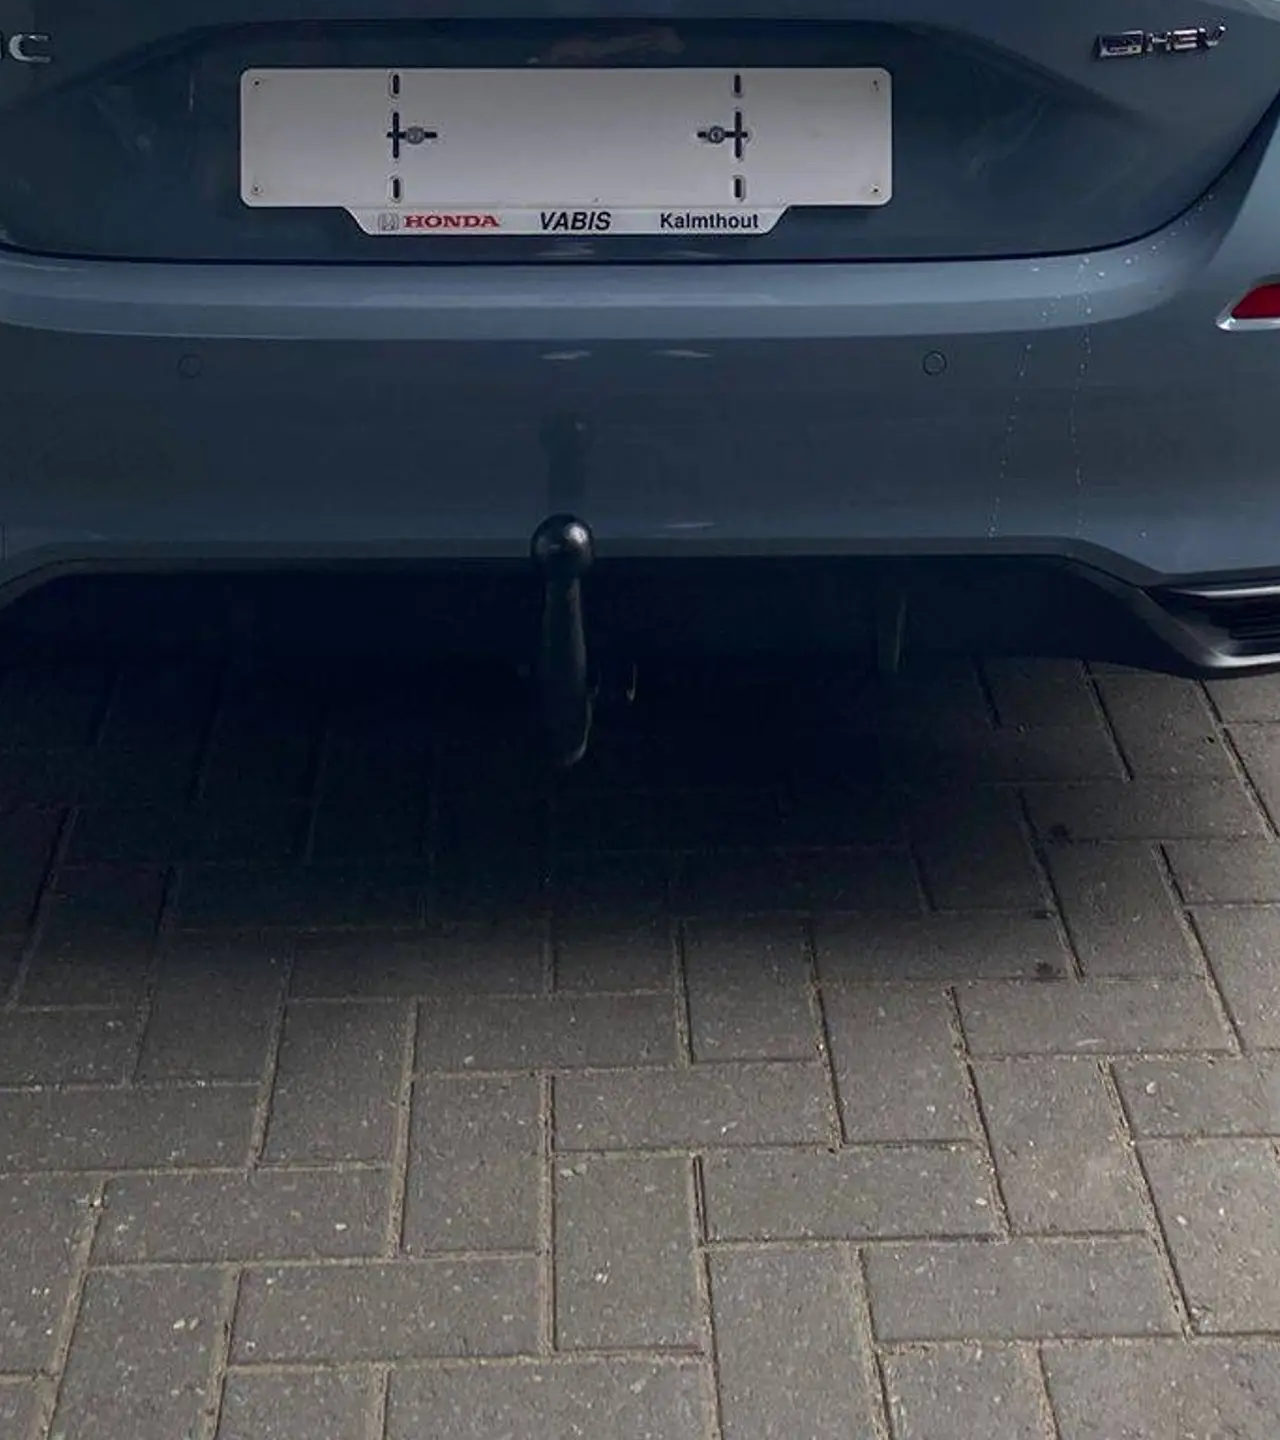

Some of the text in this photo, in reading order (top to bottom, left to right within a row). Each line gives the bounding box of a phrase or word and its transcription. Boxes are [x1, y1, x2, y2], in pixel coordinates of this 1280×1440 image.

[403, 212, 759, 231] HONDA VABIS Kalmthout
